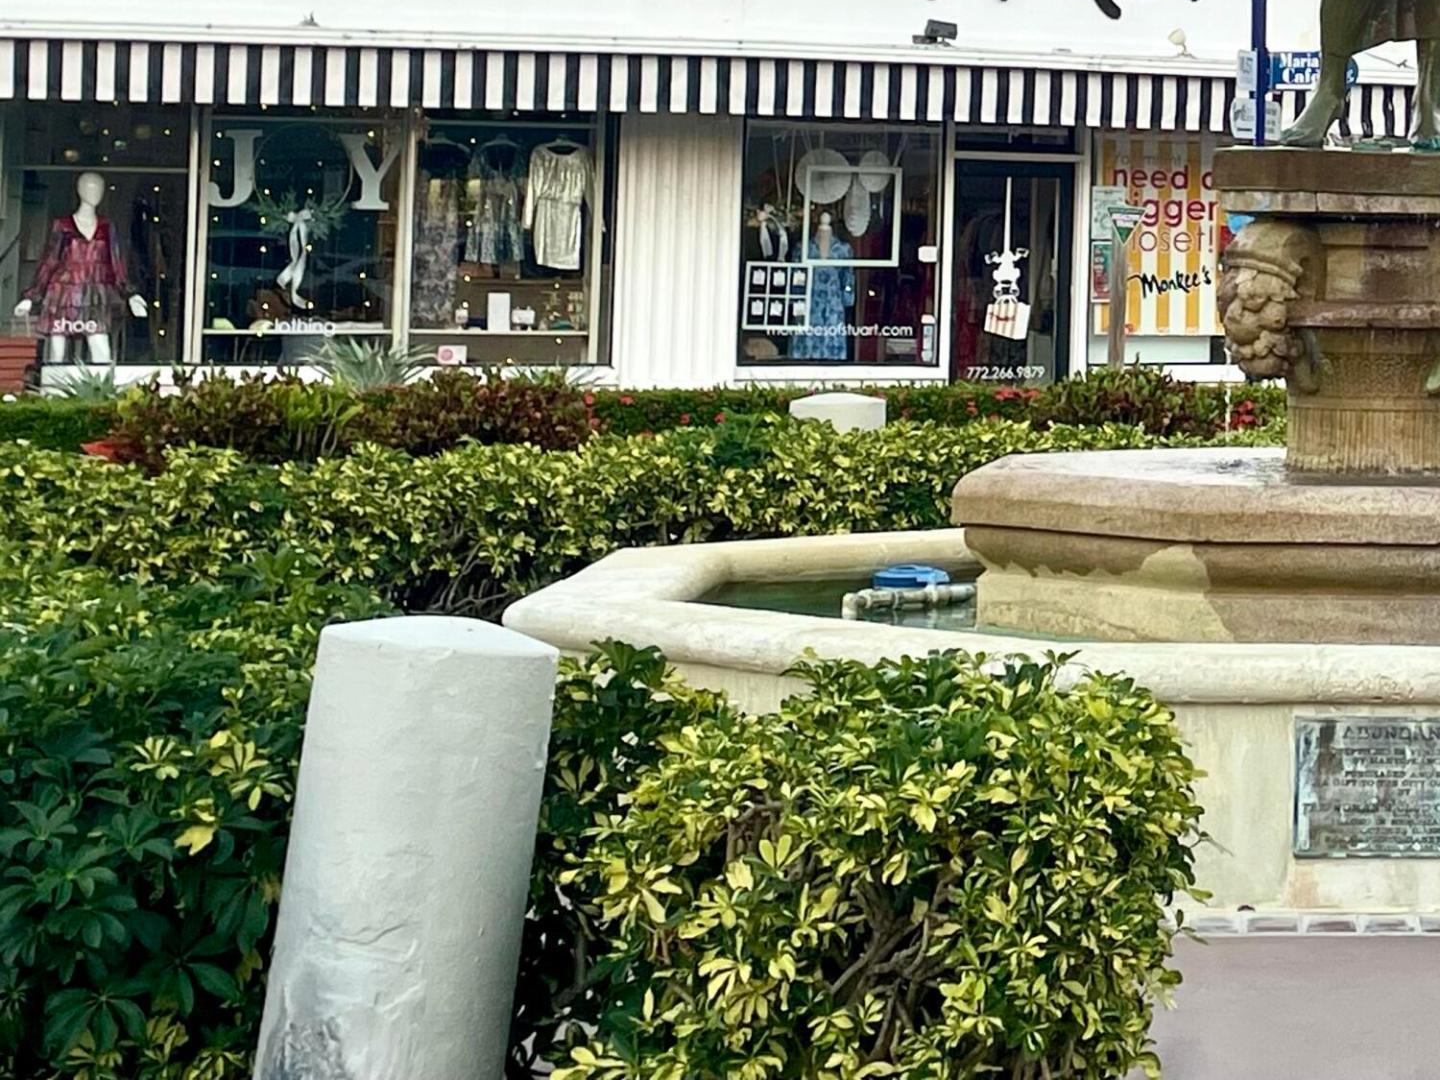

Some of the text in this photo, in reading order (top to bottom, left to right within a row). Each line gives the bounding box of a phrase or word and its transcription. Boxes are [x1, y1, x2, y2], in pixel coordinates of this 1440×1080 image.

[1113, 165, 1188, 190] need
[1125, 191, 1218, 227] igger
[1132, 225, 1214, 253] loset!
[1126, 265, 1212, 299] Monkee's
[52, 318, 98, 333] shoe
[262, 317, 337, 337] clothing
